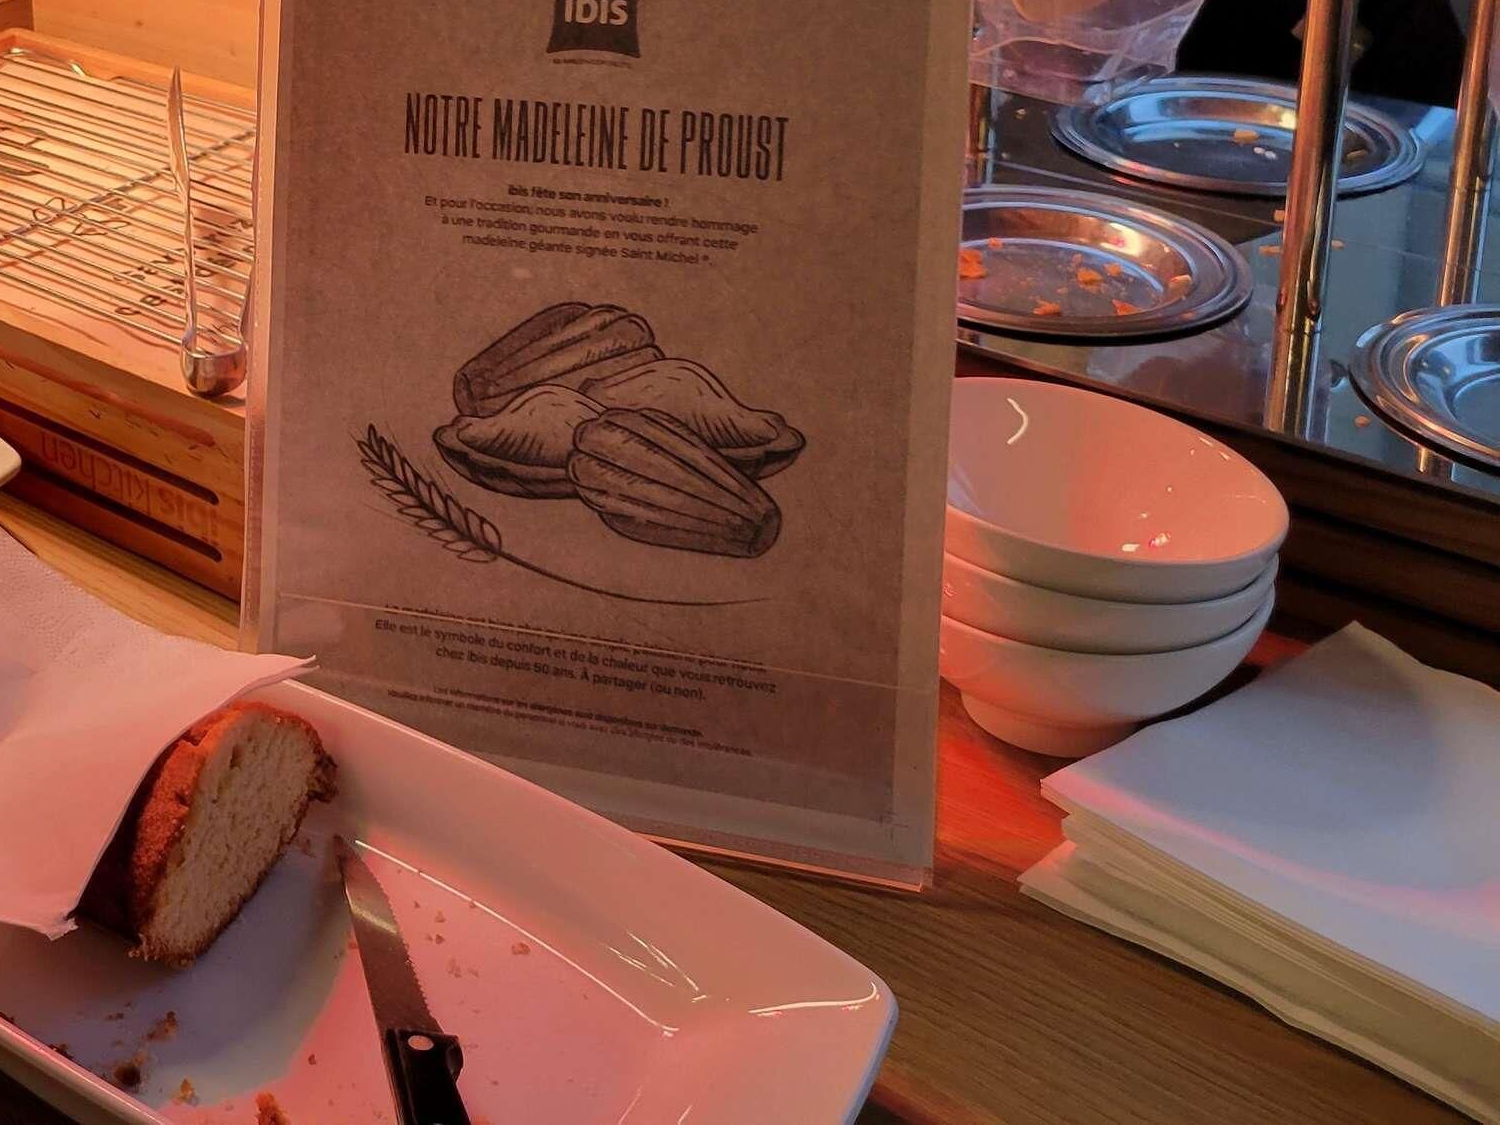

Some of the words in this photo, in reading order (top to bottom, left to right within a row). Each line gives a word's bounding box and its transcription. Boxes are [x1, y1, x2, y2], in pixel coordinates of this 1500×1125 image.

[404, 92, 483, 159] NOTRE
[492, 98, 629, 171] MADELEINE
[639, 107, 670, 173] DE
[680, 110, 789, 182] PROUST
[424, 195, 437, 206] Et
[440, 198, 468, 211] pour
[535, 207, 566, 218] nous
[570, 209, 607, 221] avons
[609, 212, 645, 224] voulu
[646, 215, 689, 227] rendre
[691, 216, 759, 236] hommage
[531, 186, 556, 199] fête
[558, 190, 581, 201] son
[583, 191, 663, 208] anniversaire
[441, 213, 450, 225] à
[451, 216, 474, 227] une
[476, 218, 527, 232] tradition
[529, 223, 600, 239] gourmande
[603, 229, 620, 240] en
[623, 231, 654, 243] vous
[656, 232, 700, 247] offrant
[703, 238, 739, 251] cette
[529, 240, 573, 253] géante
[575, 245, 618, 258] signée
[620, 247, 653, 260] Saint
[655, 250, 699, 265] Michel
[41, 432, 150, 515] kitchen
[375, 618, 397, 633] Elle
[400, 624, 418, 636] est
[420, 625, 432, 638] le
[434, 630, 486, 647] symbole
[488, 636, 505, 650] du
[507, 640, 552, 658] confort
[553, 646, 567, 659] et
[569, 649, 586, 662] de
[587, 651, 599, 666] la
[601, 655, 649, 673] chaleur
[651, 666, 677, 680] que
[680, 669, 711, 683] vous
[712, 674, 777, 694] retrouvez
[435, 646, 465, 660] chez
[490, 653, 532, 672] depuis
[533, 661, 550, 675] 50
[552, 666, 577, 680] ans.
[579, 668, 590, 682] À
[592, 673, 648, 692] partager
[649, 681, 672, 696] (ou
[673, 686, 706, 700] non).
